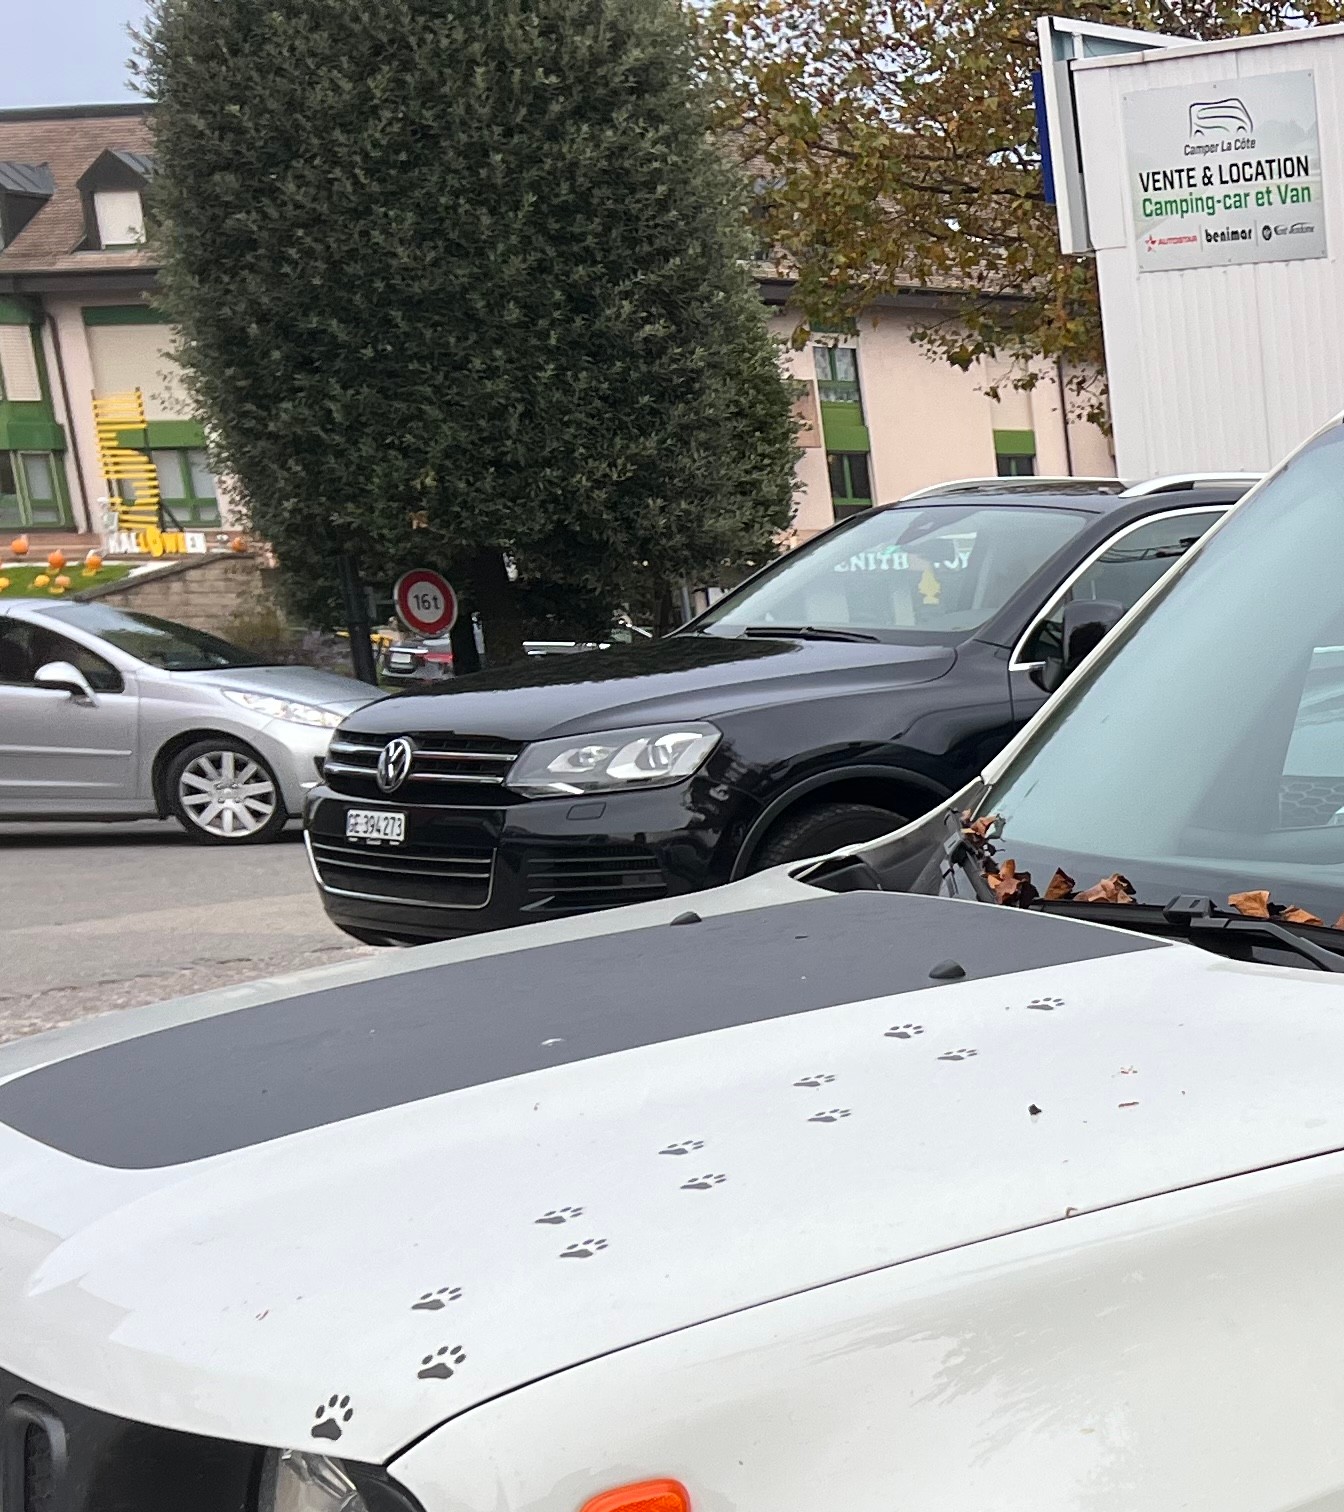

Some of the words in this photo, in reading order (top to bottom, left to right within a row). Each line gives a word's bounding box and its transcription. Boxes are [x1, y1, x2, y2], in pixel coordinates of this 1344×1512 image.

[1221, 140, 1232, 152] La
[1139, 167, 1197, 192] VENTE
[1202, 166, 1213, 186] &
[1218, 155, 1309, 184] LOCATION
[1142, 190, 1250, 219] Camping-car
[1255, 186, 1272, 207] et
[1277, 184, 1312, 204] Van
[1204, 226, 1252, 243] benimar
